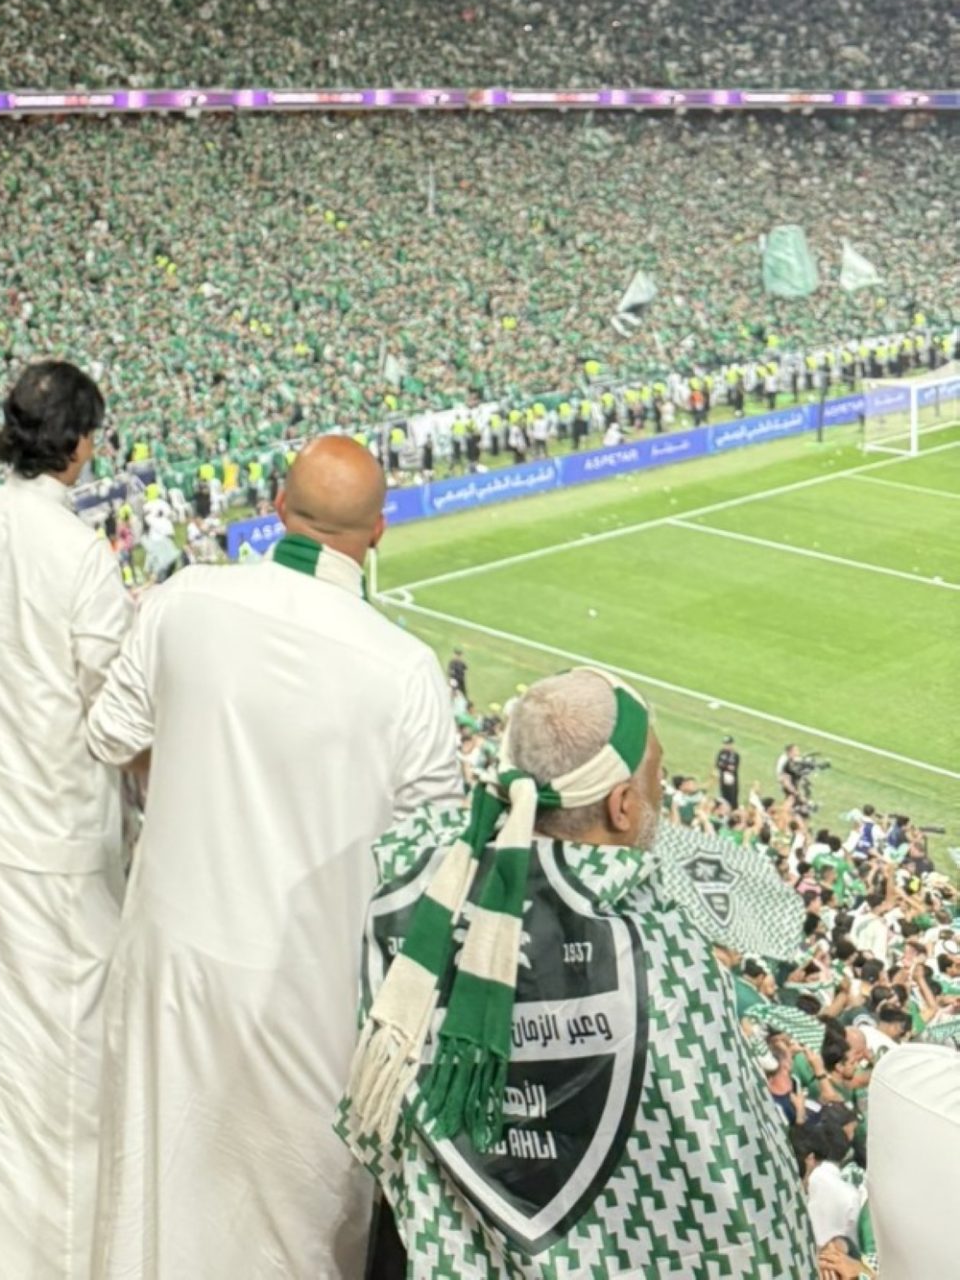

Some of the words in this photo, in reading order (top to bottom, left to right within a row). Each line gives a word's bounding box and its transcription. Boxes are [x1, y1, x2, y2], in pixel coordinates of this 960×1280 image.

[563, 942, 594, 964] 1937
[567, 1011, 613, 1047] وعبر
[508, 1127, 558, 1160] AHLI
